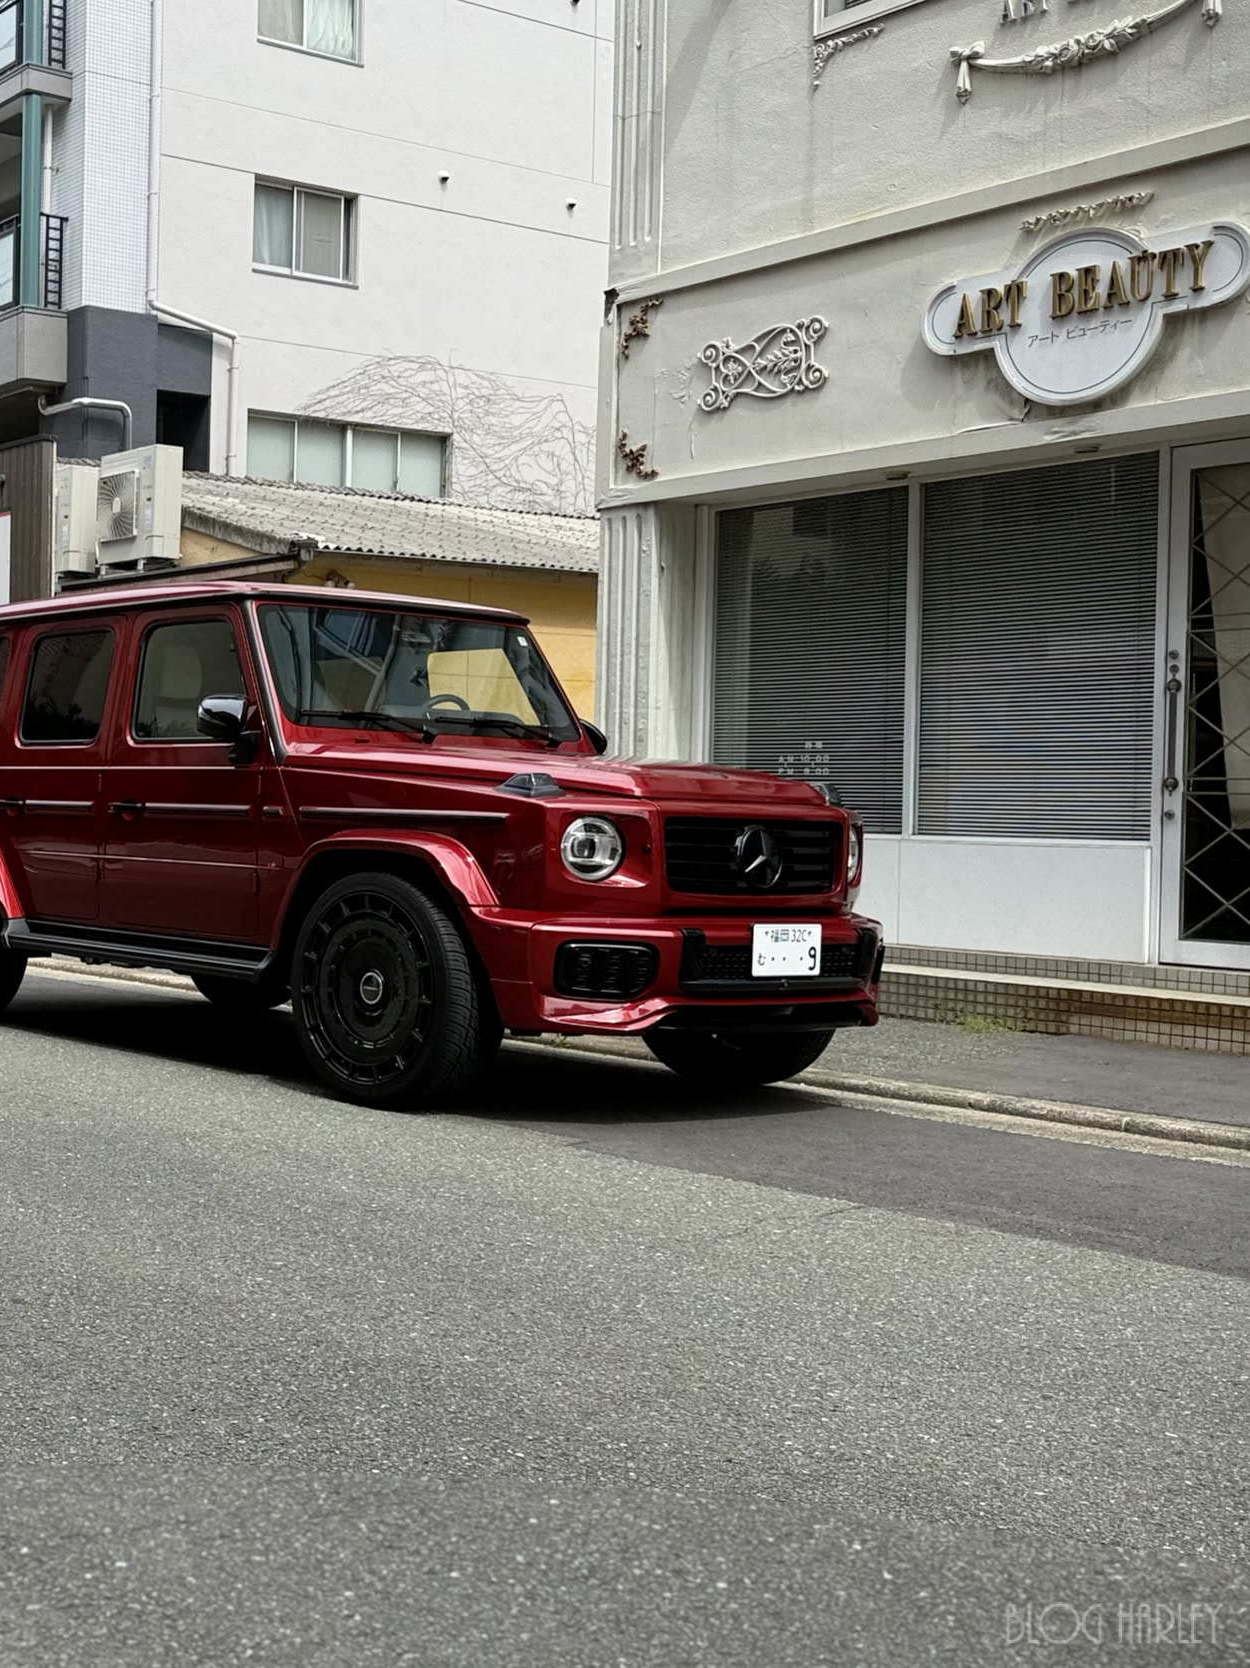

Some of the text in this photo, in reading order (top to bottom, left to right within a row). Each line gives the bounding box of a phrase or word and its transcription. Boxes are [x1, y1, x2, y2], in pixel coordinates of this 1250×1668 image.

[952, 239, 1215, 338] ART BEAUTY
[1027, 319, 1132, 348] アート ビューティー
